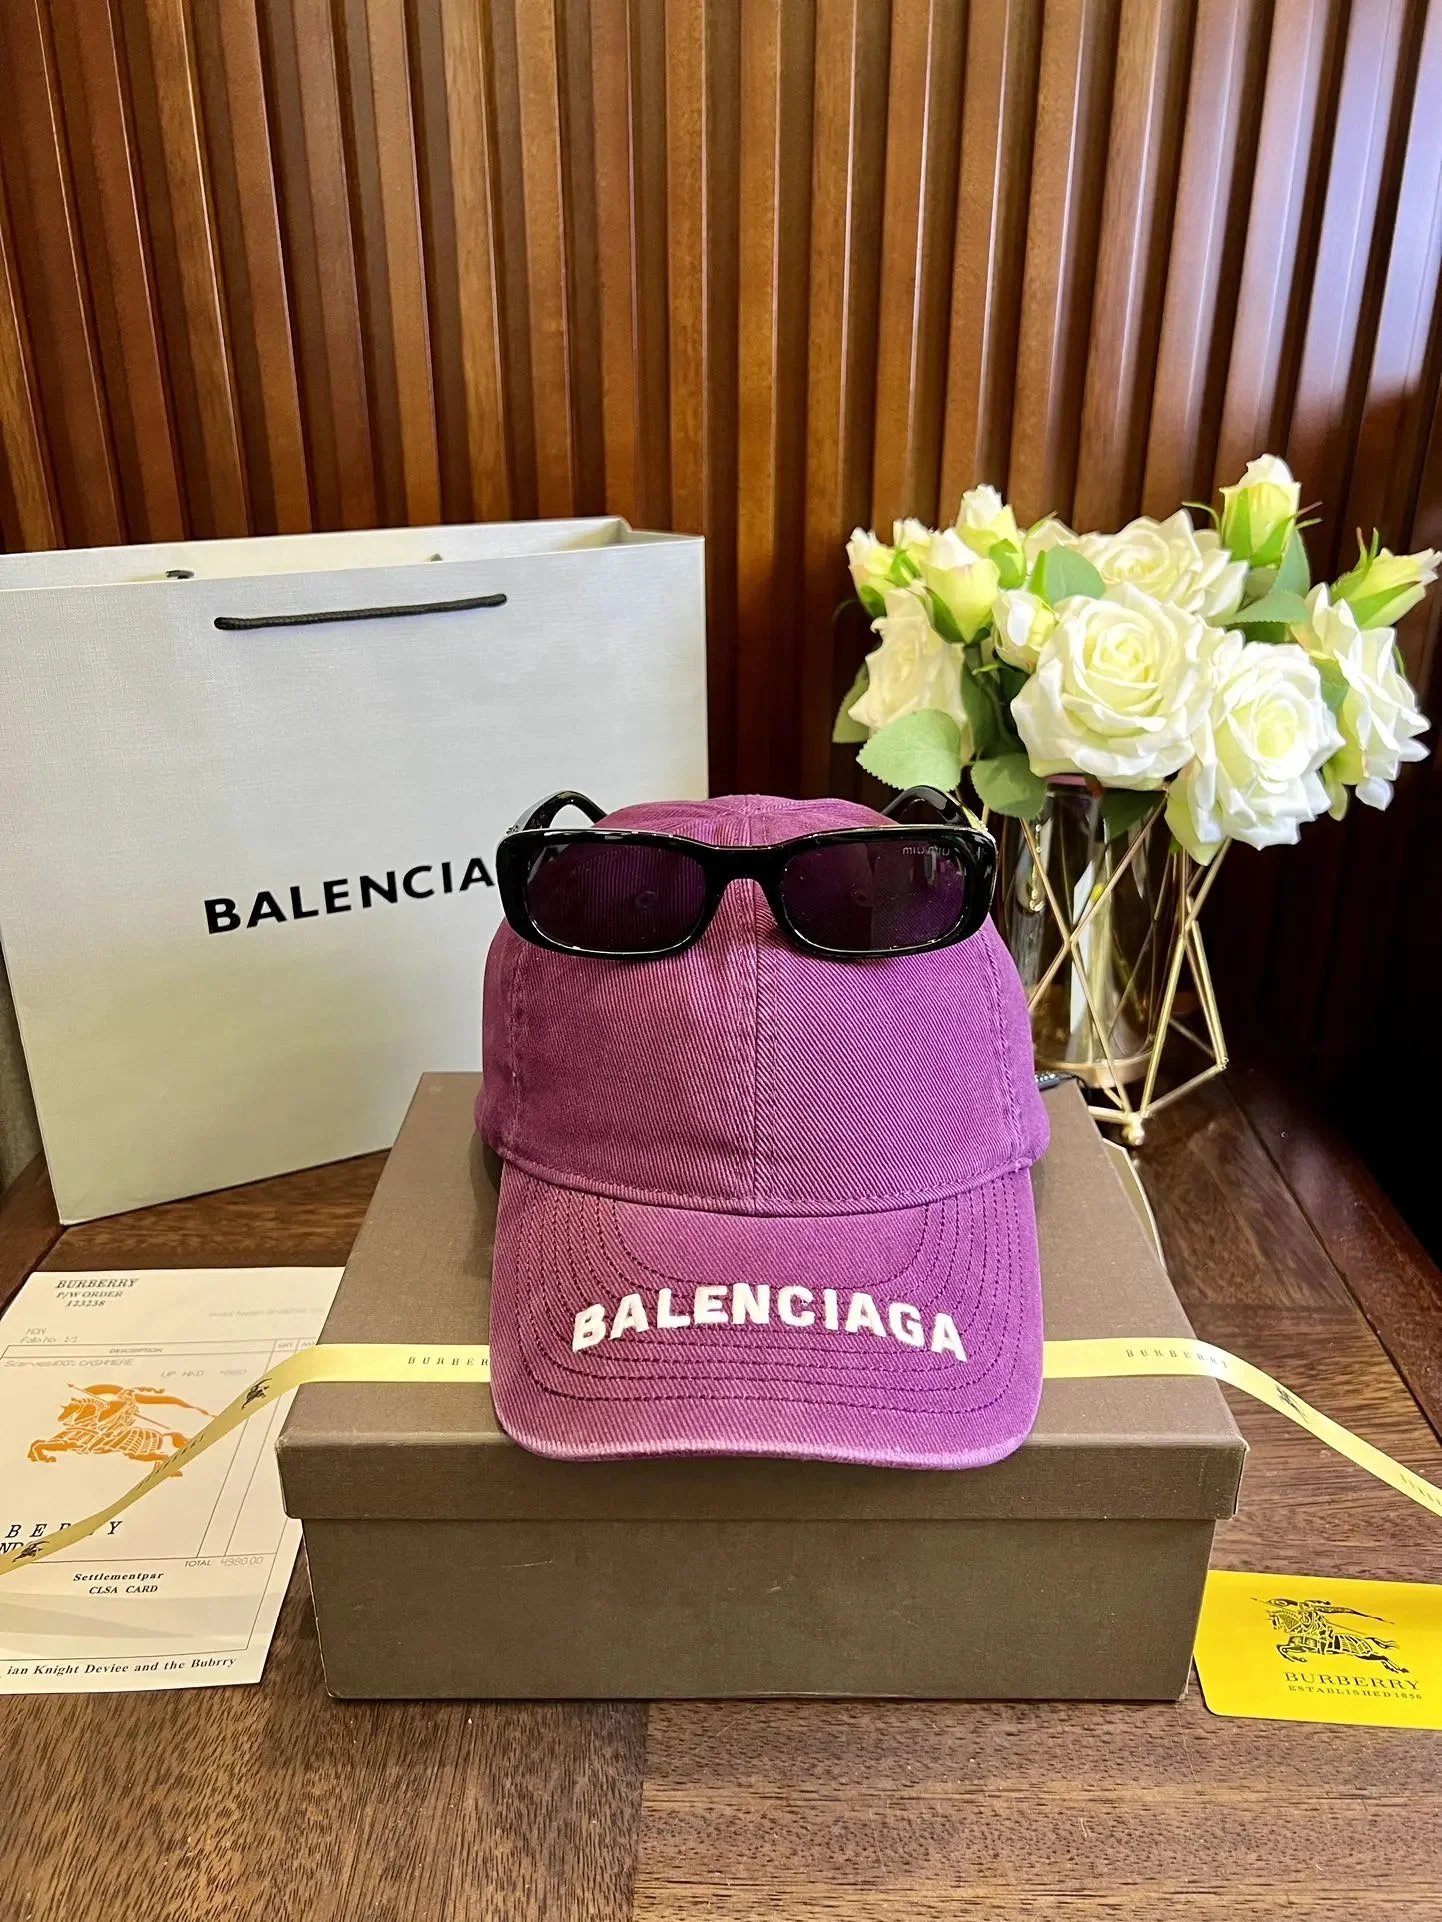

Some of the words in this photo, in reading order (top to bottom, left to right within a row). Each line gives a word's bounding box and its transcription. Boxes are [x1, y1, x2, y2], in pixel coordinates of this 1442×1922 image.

[203, 857, 495, 935] BALENCIA
[55, 1278, 139, 1289] BURBERRY
[571, 1282, 968, 1363] BALENCIAGA
[408, 1356, 490, 1367] BURBER
[184, 1559, 212, 1568] TOTAL
[72, 1571, 165, 1583] Settlementpar
[125, 1585, 159, 1594] CARD
[33, 1664, 80, 1677] Knight
[134, 1662, 159, 1672] and
[164, 1660, 186, 1670] the
[1284, 1671, 1420, 1691] BURBERRY
